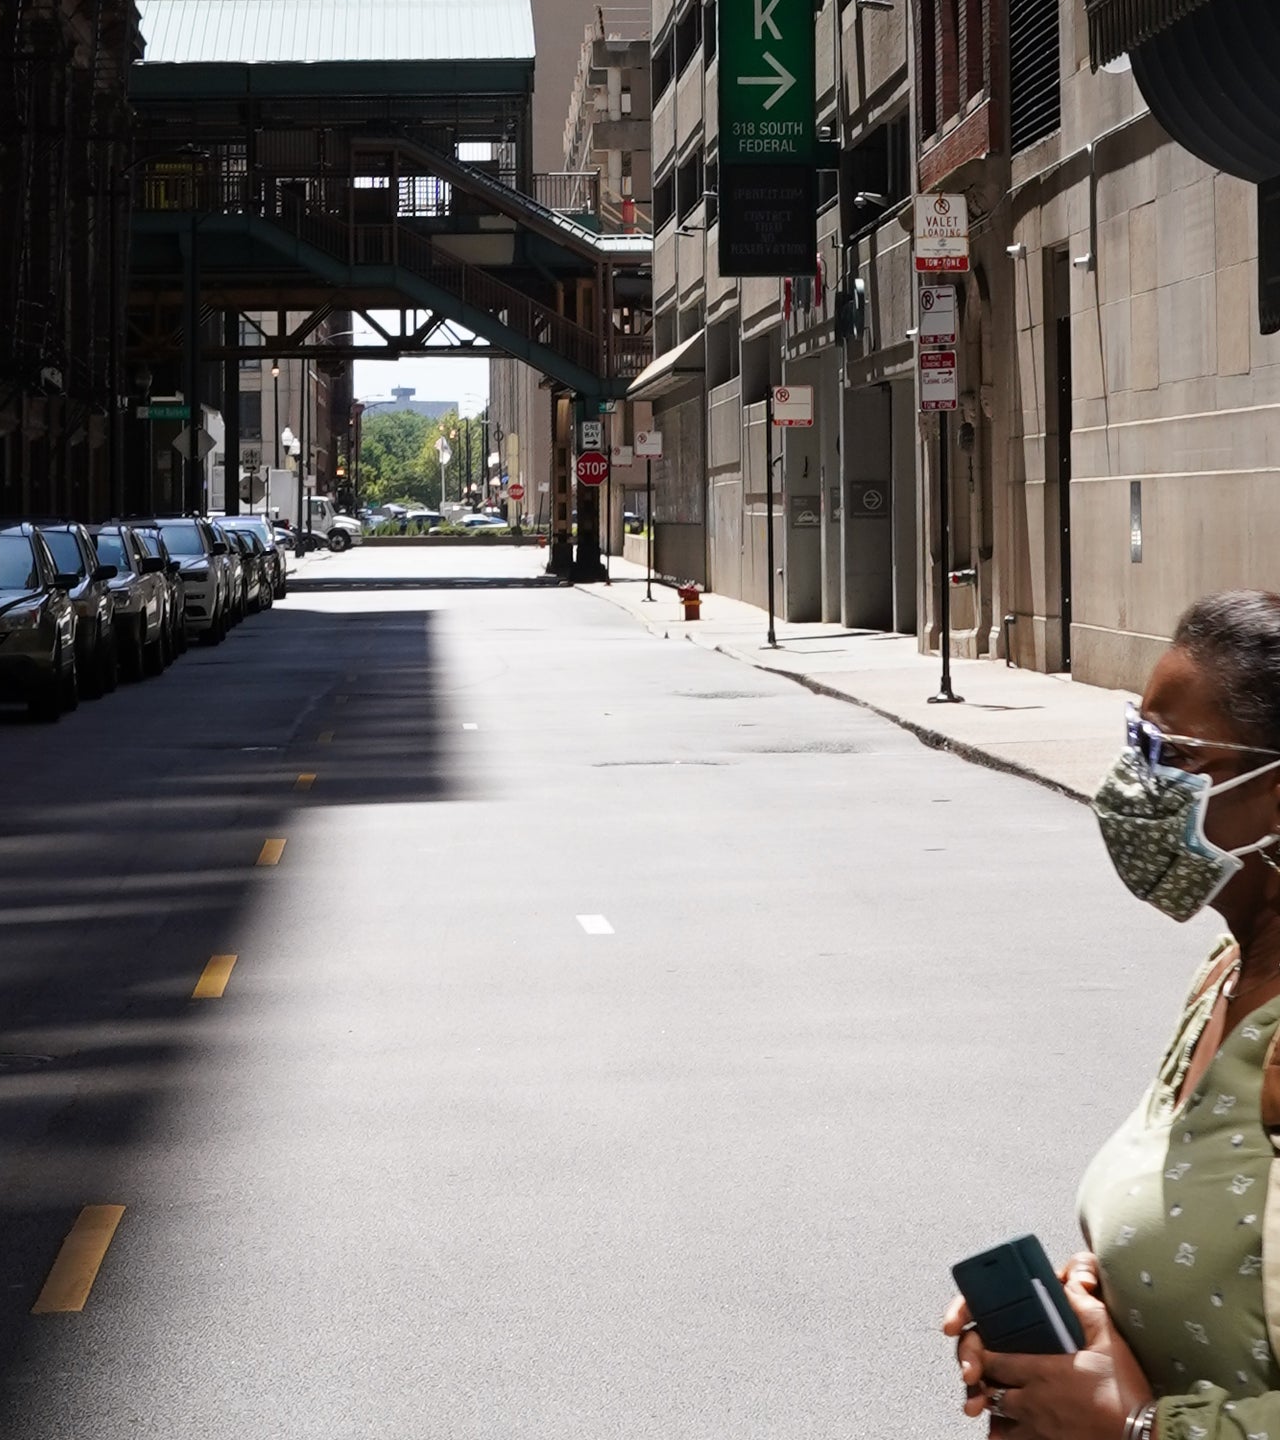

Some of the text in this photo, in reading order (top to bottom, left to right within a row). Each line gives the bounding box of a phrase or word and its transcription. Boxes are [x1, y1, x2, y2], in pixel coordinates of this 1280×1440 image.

[732, 121, 803, 136] 318 SOUTH
[739, 139, 797, 152] FEDERAL
[926, 216, 958, 228] VALET
[923, 229, 961, 238] LOADING
[578, 462, 607, 475] STOP
